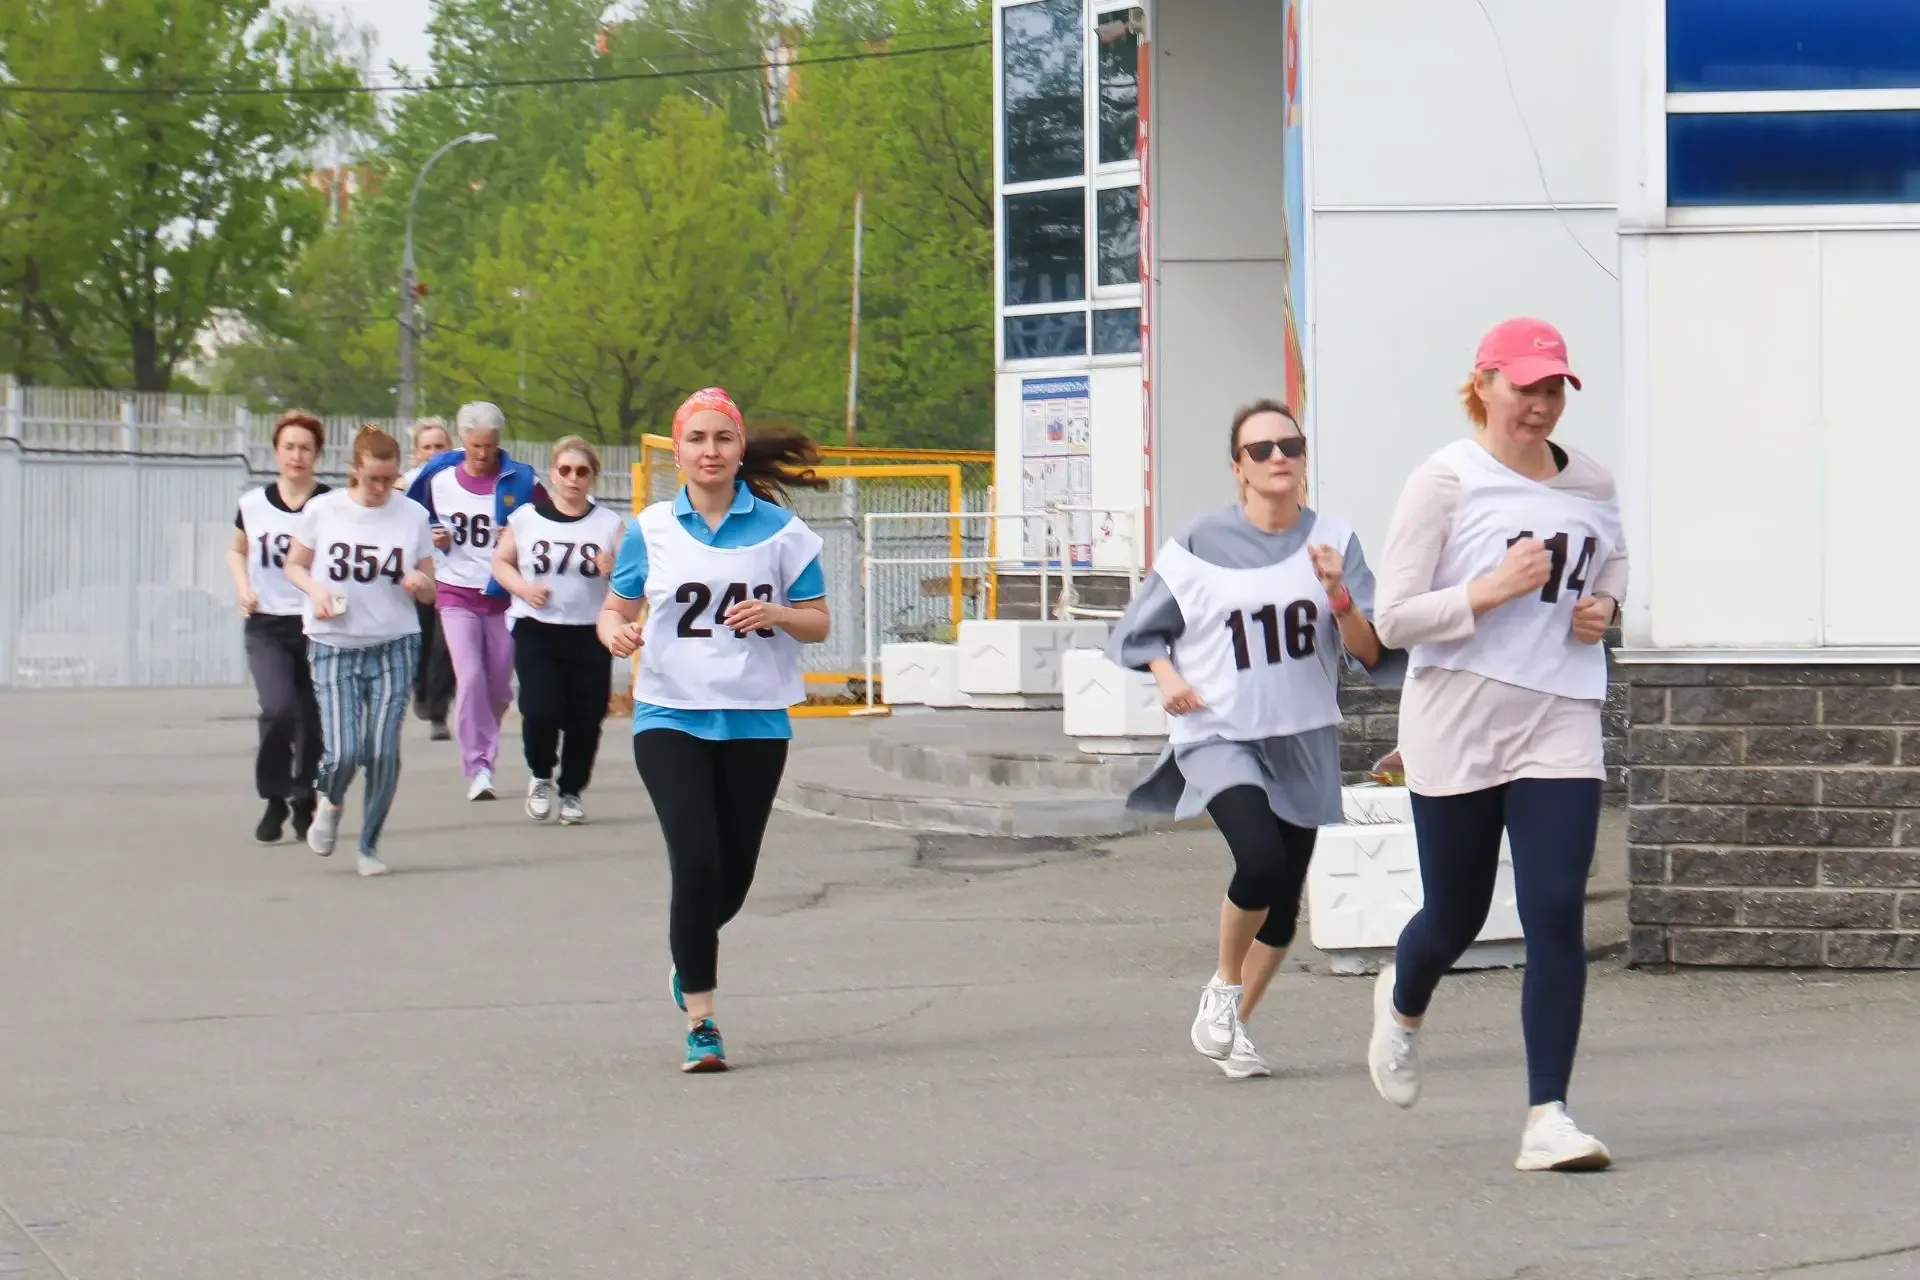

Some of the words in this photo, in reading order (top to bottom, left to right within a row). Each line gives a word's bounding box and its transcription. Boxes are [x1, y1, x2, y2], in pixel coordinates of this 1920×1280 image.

[450, 512, 497, 548] 36
[328, 542, 404, 585] 354
[532, 540, 602, 578] 378
[1506, 530, 1596, 604] 14
[1224, 599, 1318, 672] 116
